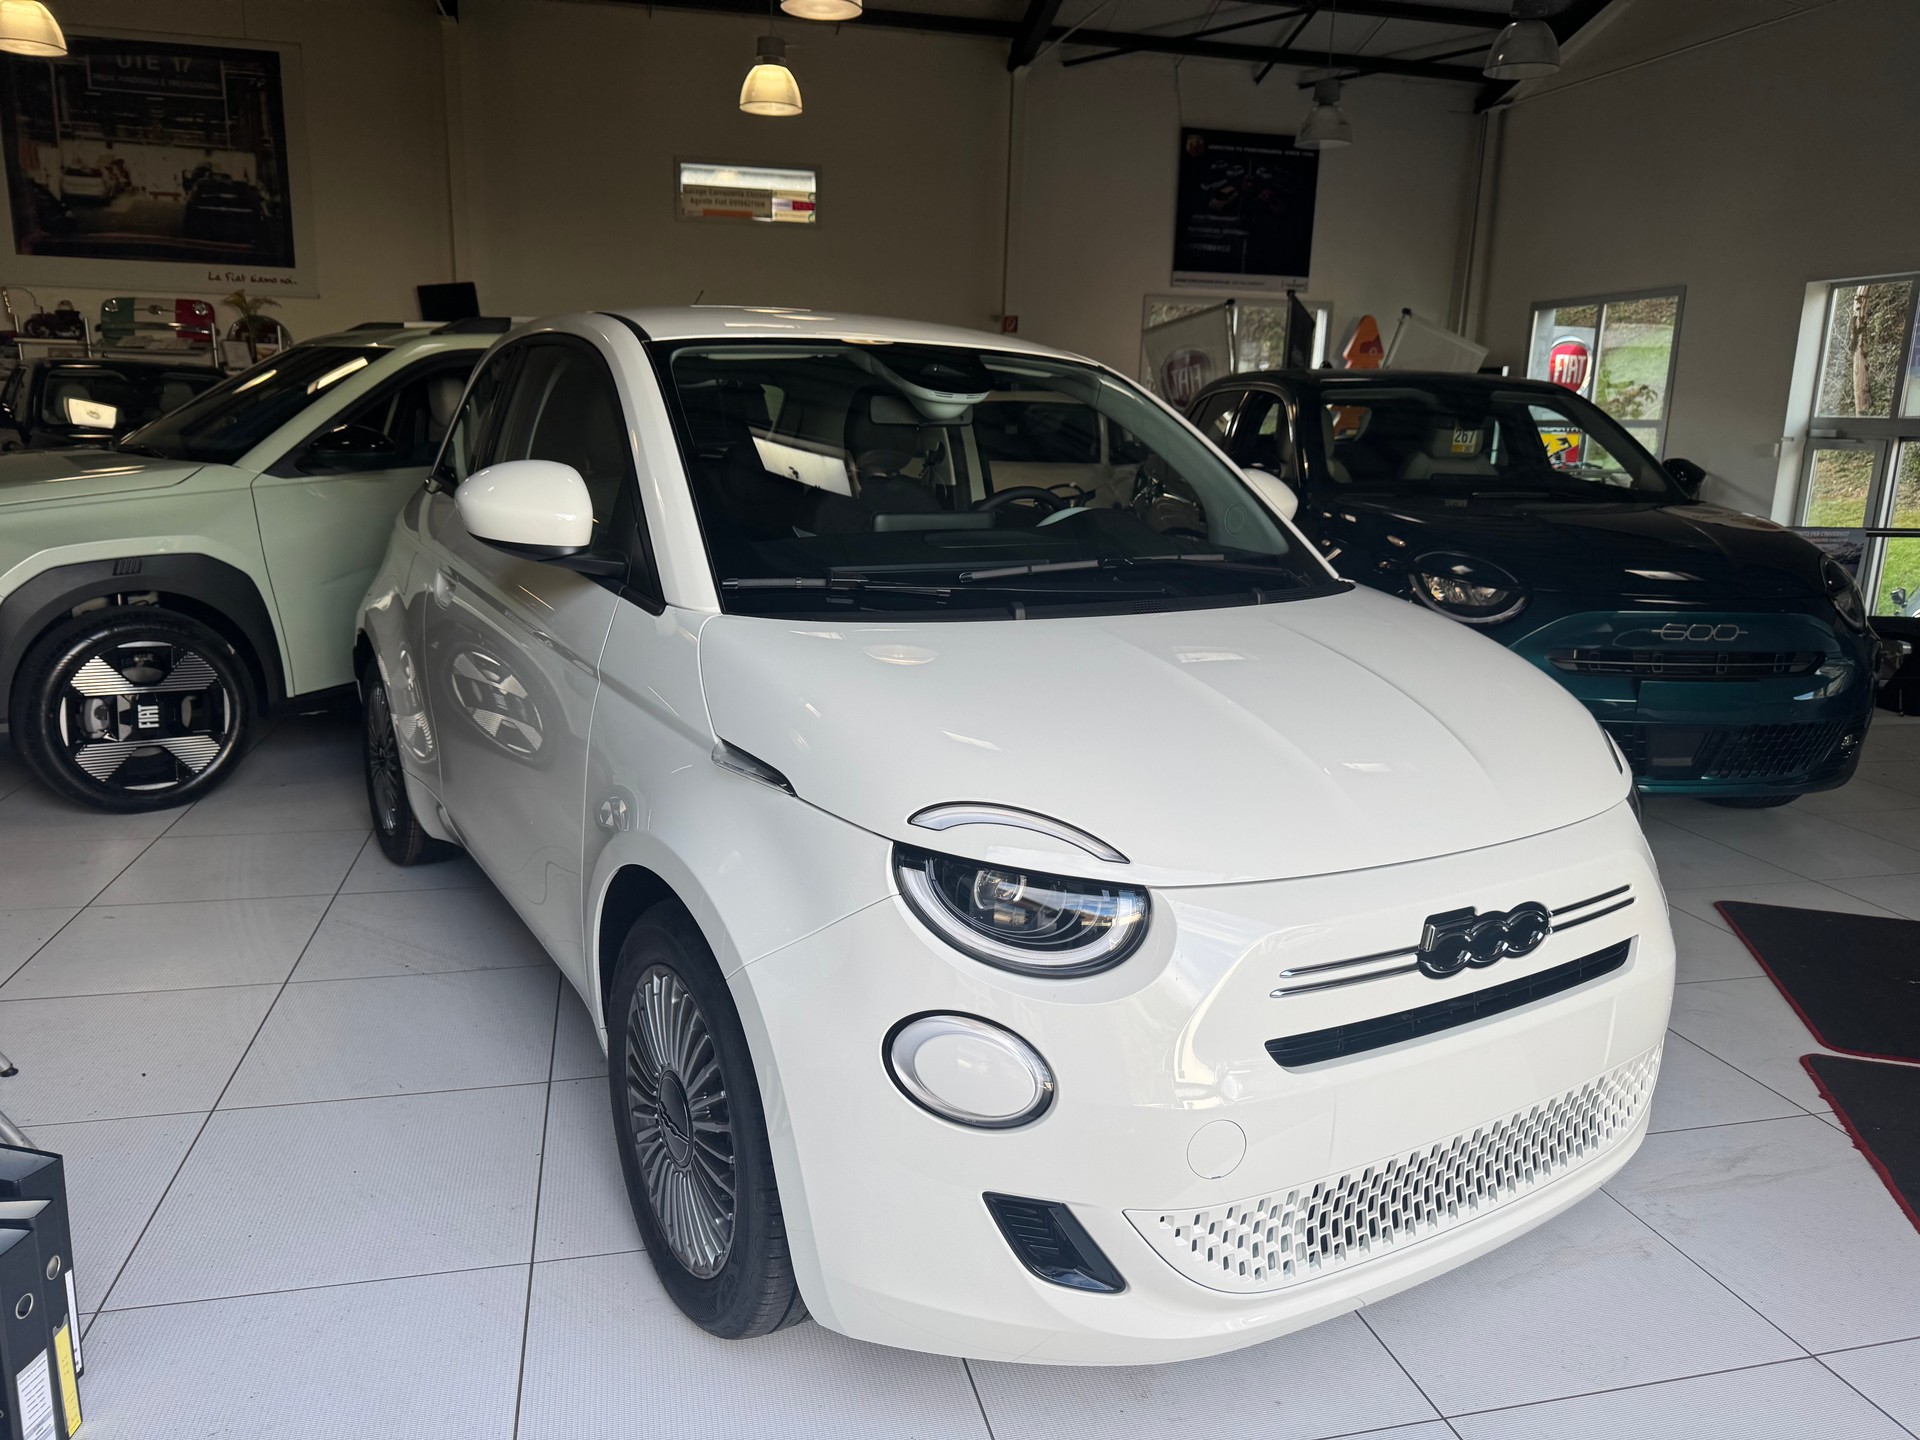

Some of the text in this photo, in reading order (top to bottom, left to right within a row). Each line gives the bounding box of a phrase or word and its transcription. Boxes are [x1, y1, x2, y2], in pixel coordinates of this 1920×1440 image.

[208, 271, 221, 281] La
[225, 271, 245, 282] Fiat
[1553, 353, 1587, 384] FIAT
[1454, 428, 1475, 443] 267
[1660, 623, 1740, 641] 600
[137, 704, 160, 729] FIAT
[1417, 900, 1550, 980] 500
